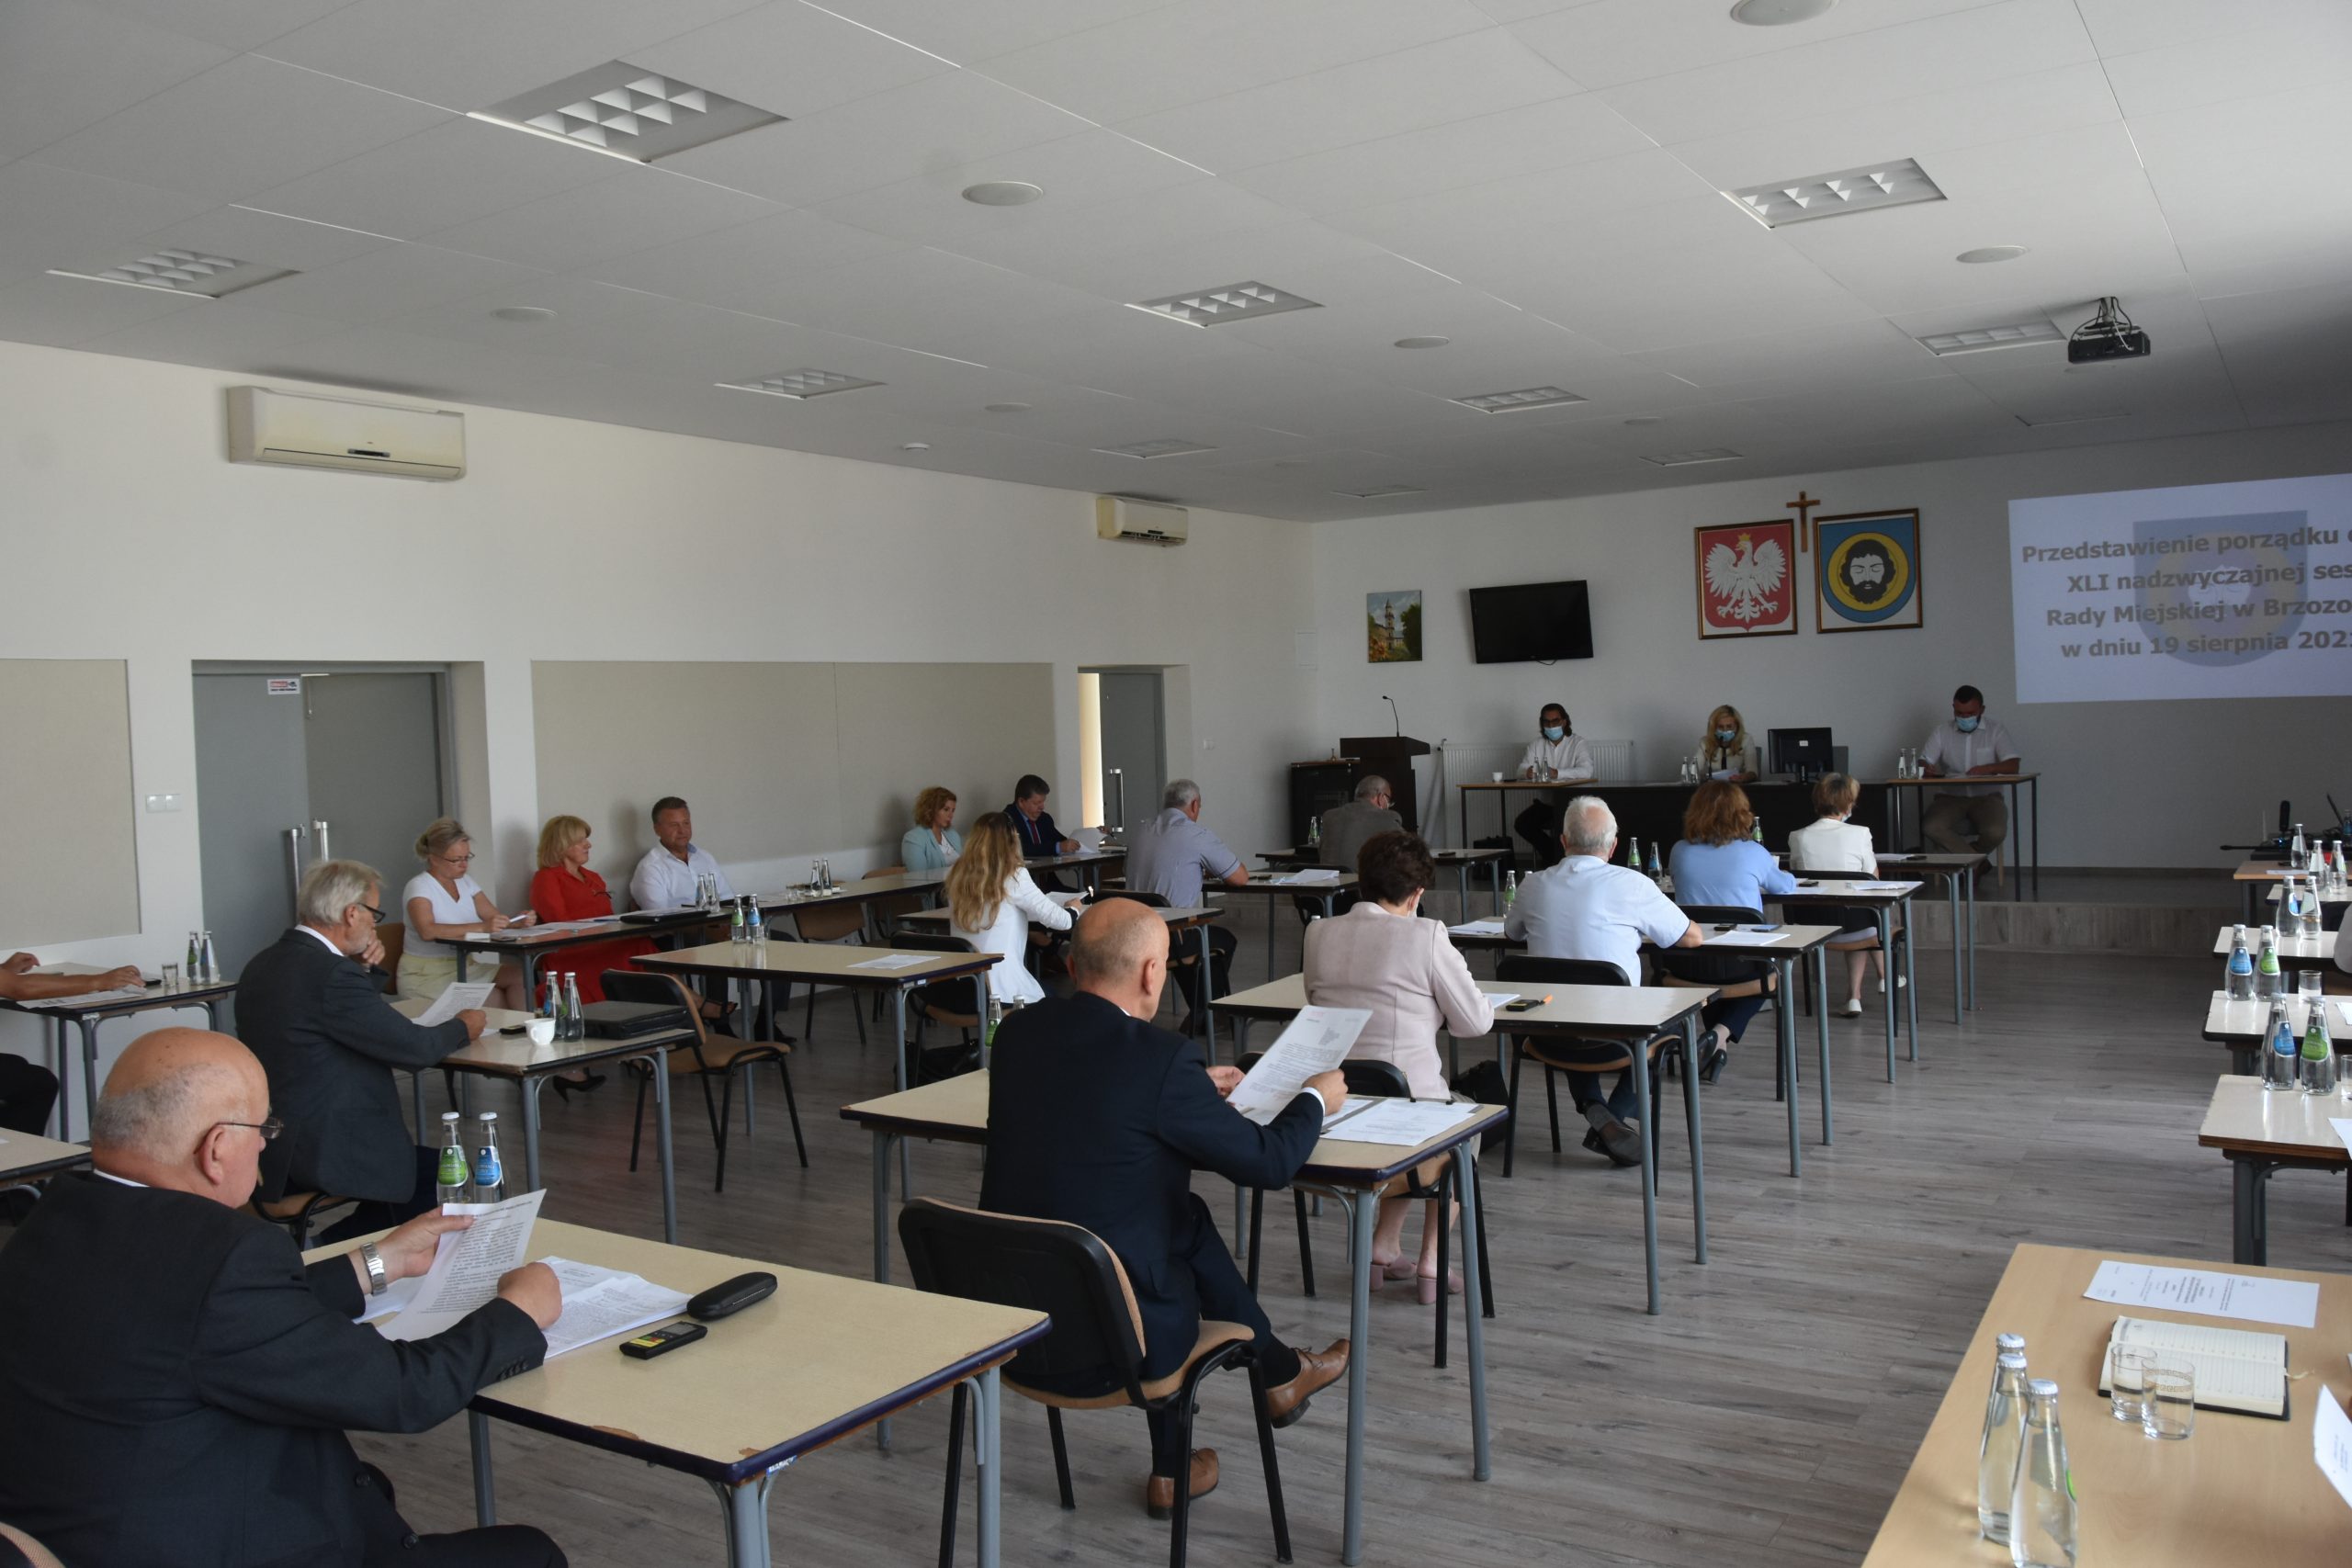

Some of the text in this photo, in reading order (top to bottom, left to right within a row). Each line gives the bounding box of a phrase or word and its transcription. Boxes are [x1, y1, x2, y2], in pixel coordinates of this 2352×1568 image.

[2022, 535, 2210, 562] Przedstawienie
[2217, 527, 2338, 555] porządku
[2067, 574, 2109, 592] XLI
[2117, 562, 2305, 590] nadzwyczajnej
[2047, 598, 2352, 628] Rady Miejskiej w Brzozo
[2061, 630, 2352, 658] w dniu 19 sierpnia 202
